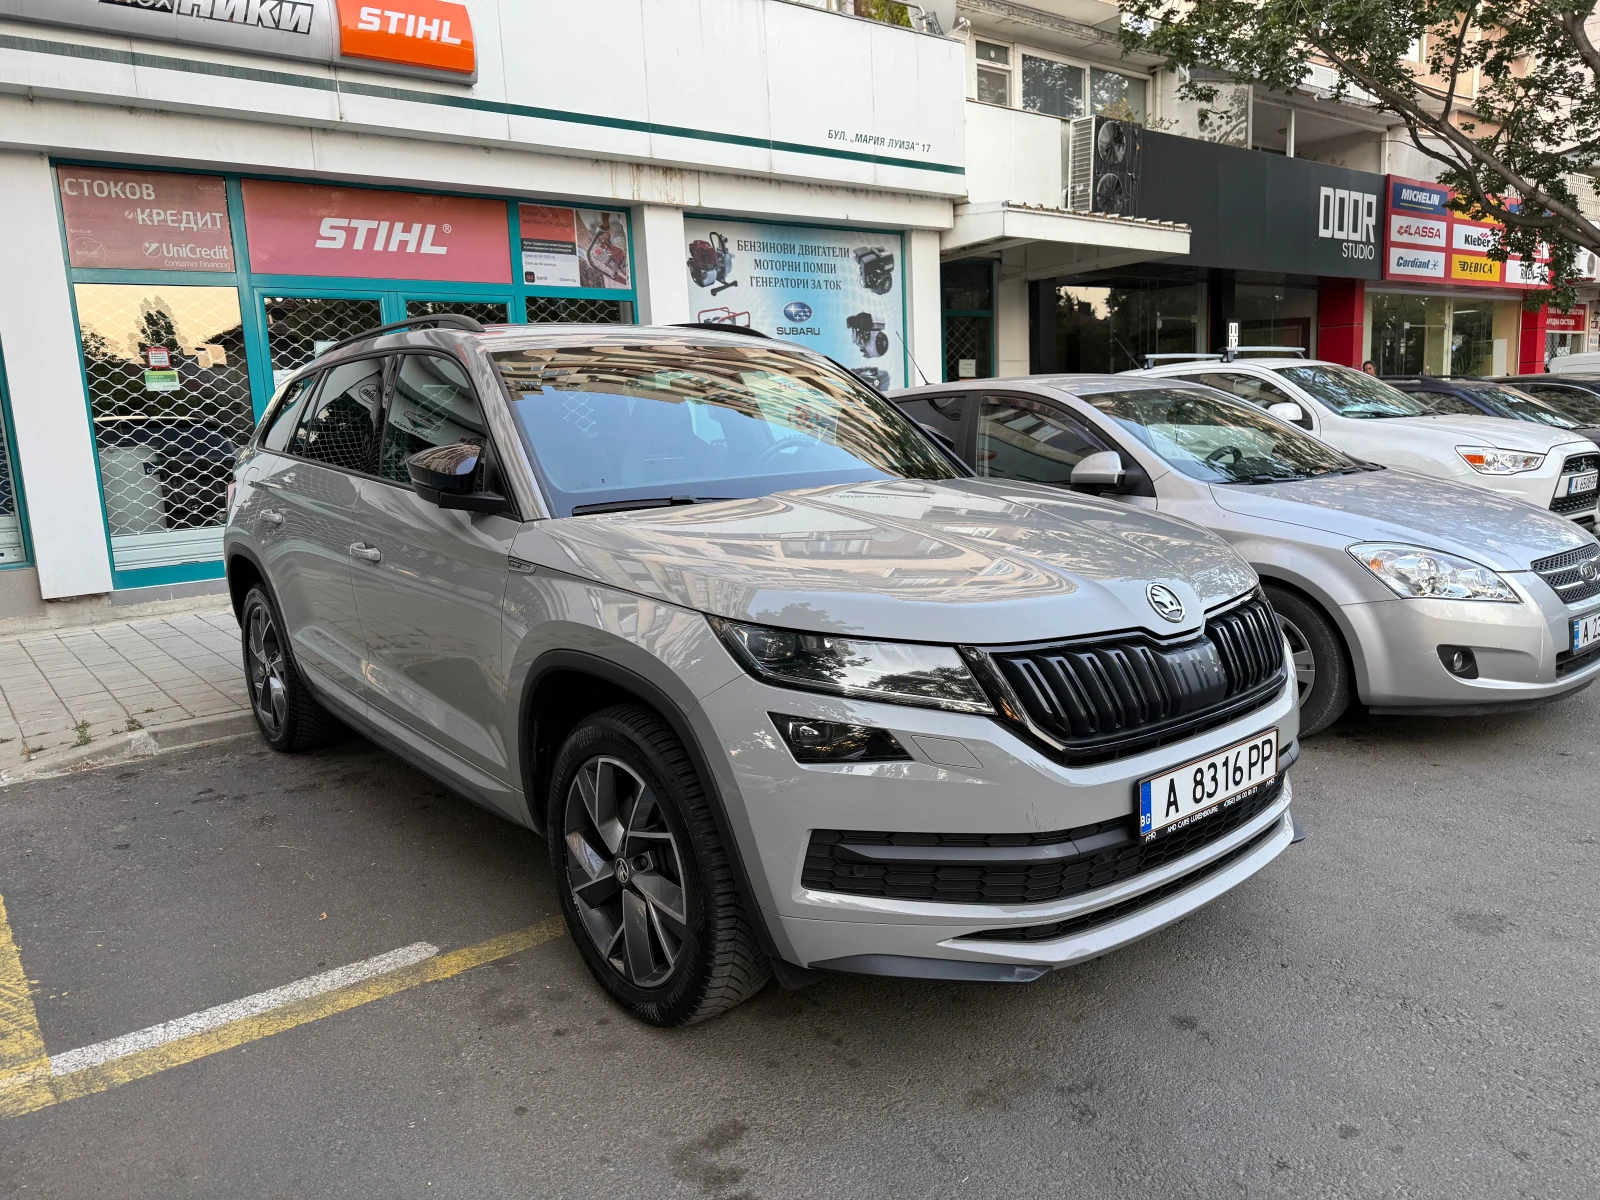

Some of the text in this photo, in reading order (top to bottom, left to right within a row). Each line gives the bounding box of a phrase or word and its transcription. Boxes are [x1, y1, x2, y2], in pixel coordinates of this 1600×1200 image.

[357, 6, 462, 44] STIHL
[827, 129, 848, 141] БУЛ.
[921, 144, 931, 153] 17
[63, 177, 156, 200] СТОКОВ
[1401, 188, 1440, 206] MICHELIN
[136, 207, 224, 232] КРЕДИТ
[1318, 186, 1377, 243] DOOR
[1408, 224, 1441, 240] LASSA
[1464, 233, 1491, 248] Kleber
[163, 242, 229, 260] UniCredit
[737, 239, 850, 258] БЕНЗИНОВИ ДВИГАТЕЛИ
[1341, 243, 1375, 260] STUDIO
[164, 259, 231, 270] Consumer Financing
[754, 258, 837, 274] МОТОРНИ ПОМПИ
[1396, 256, 1431, 270] Cordiant
[750, 276, 842, 290] ГЕНЕРАТОРИ ЗА ТОК
[776, 326, 821, 336] SUBARU
[1583, 620, 1589, 643] A
[1164, 777, 1180, 818] A
[1141, 813, 1151, 827] BG
[1177, 818, 1190, 828] CARS
